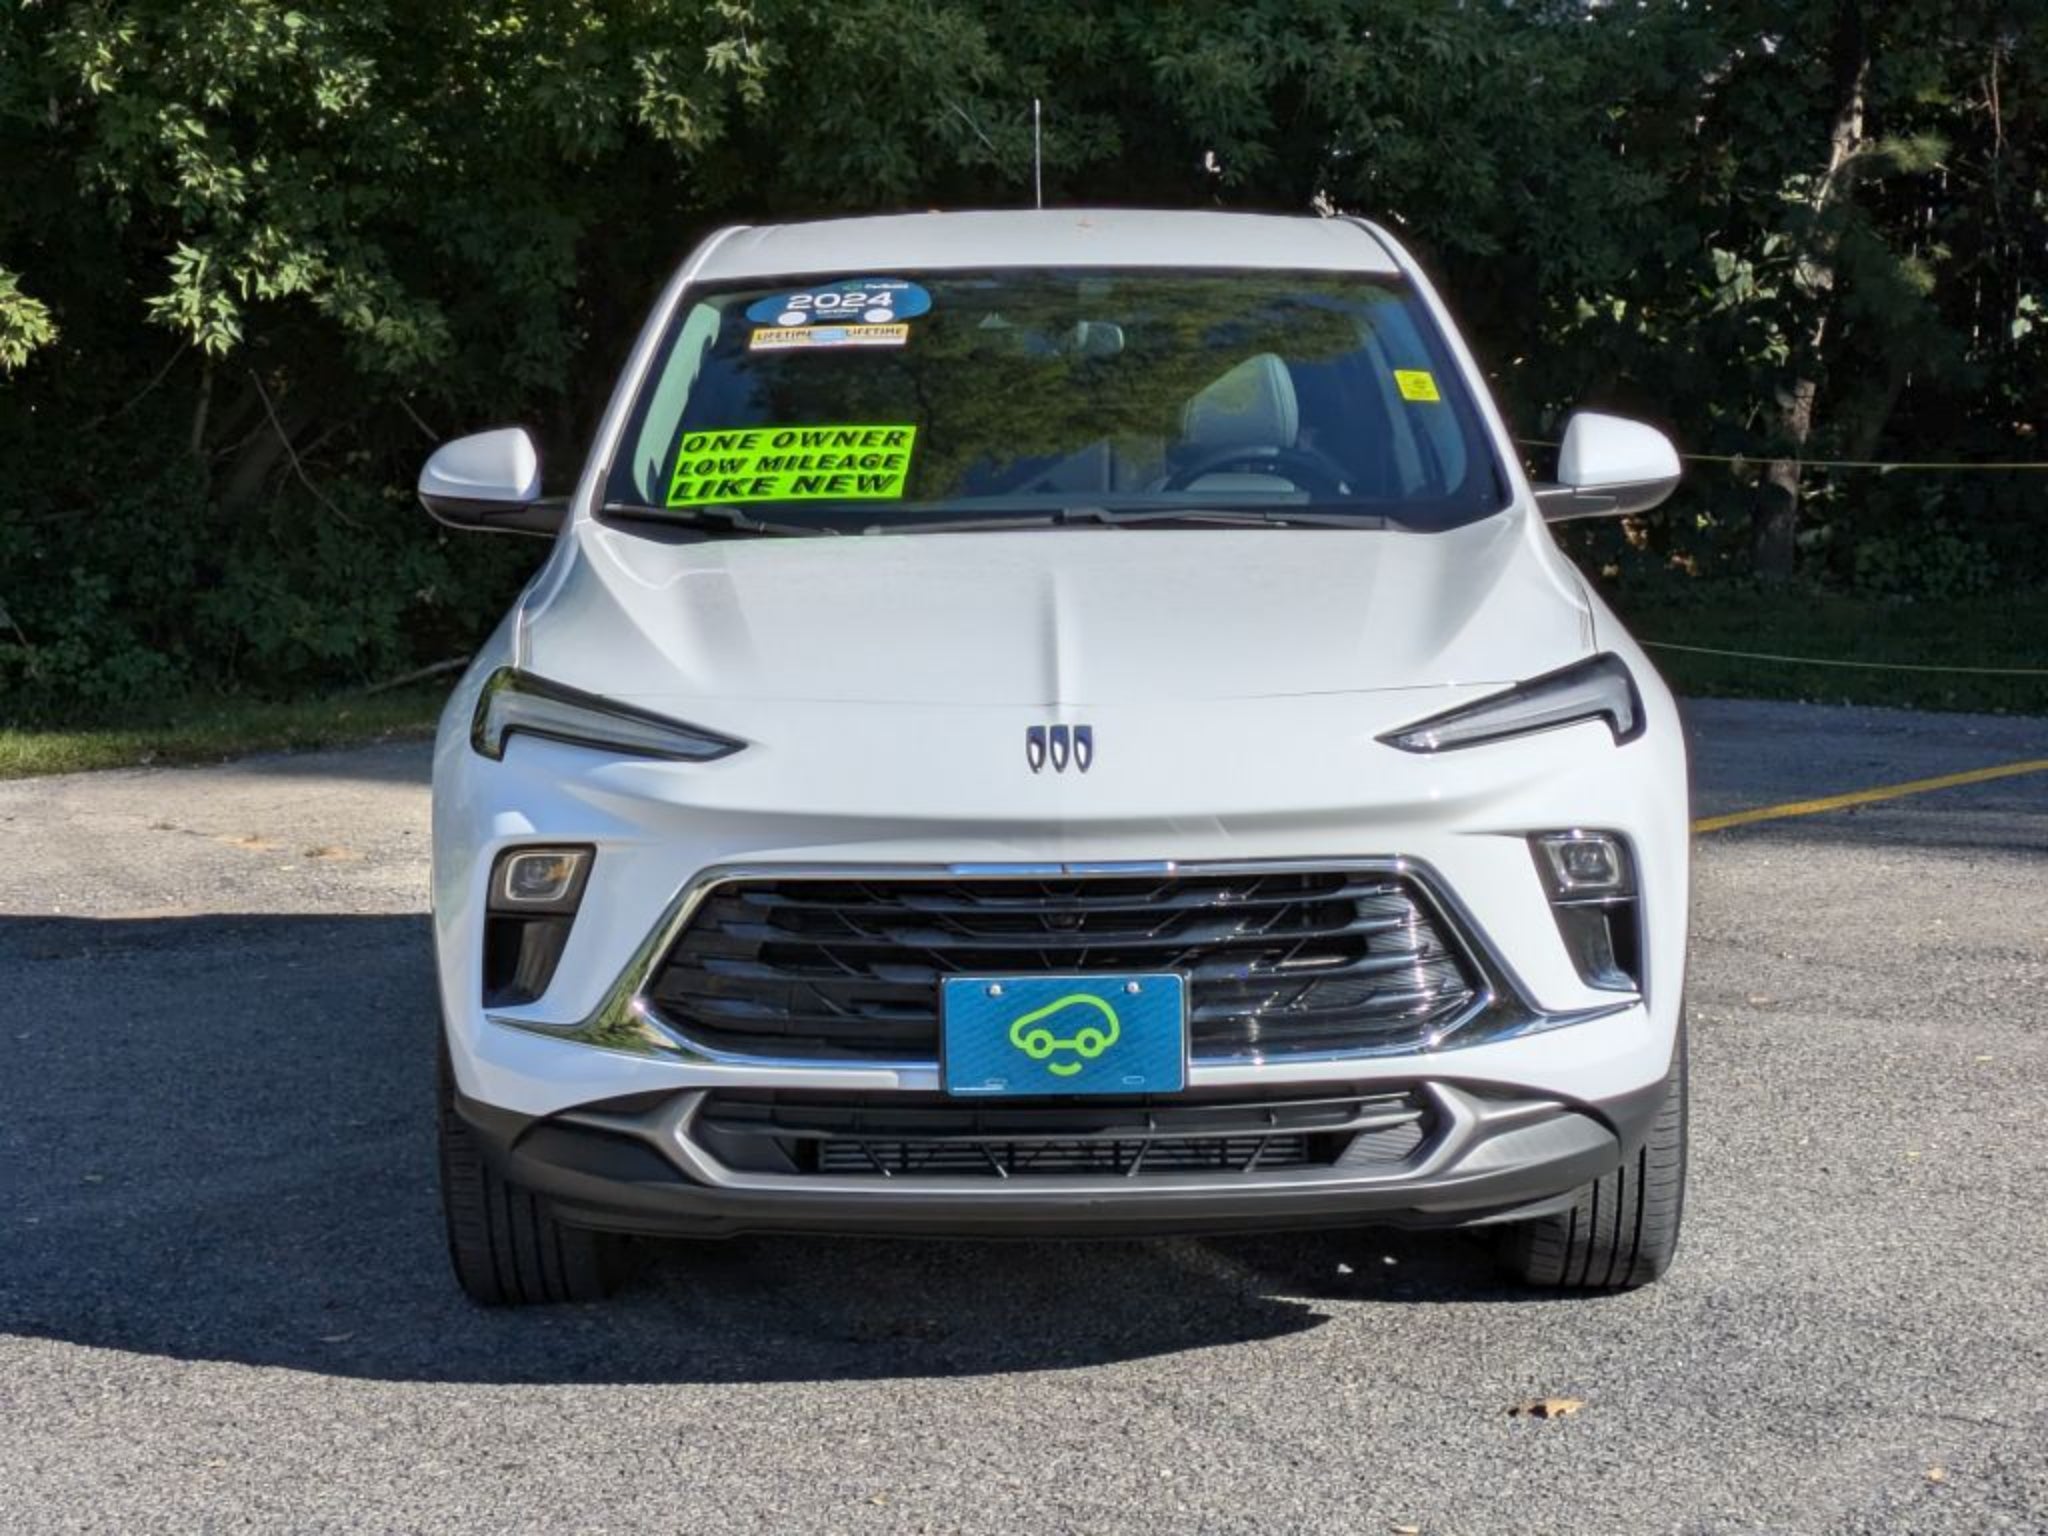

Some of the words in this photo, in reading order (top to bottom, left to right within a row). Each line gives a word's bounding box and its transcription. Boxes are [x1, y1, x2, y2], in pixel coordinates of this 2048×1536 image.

[787, 291, 893, 310] 2024
[757, 329, 811, 341] LIFETIM
[845, 327, 902, 337] LIFETIME
[683, 433, 762, 453] ONE
[772, 430, 908, 449] OWNER
[677, 457, 749, 476] LOW
[755, 453, 905, 473] MILEAGE
[671, 476, 779, 501] LIKE
[790, 474, 899, 494] NEW
